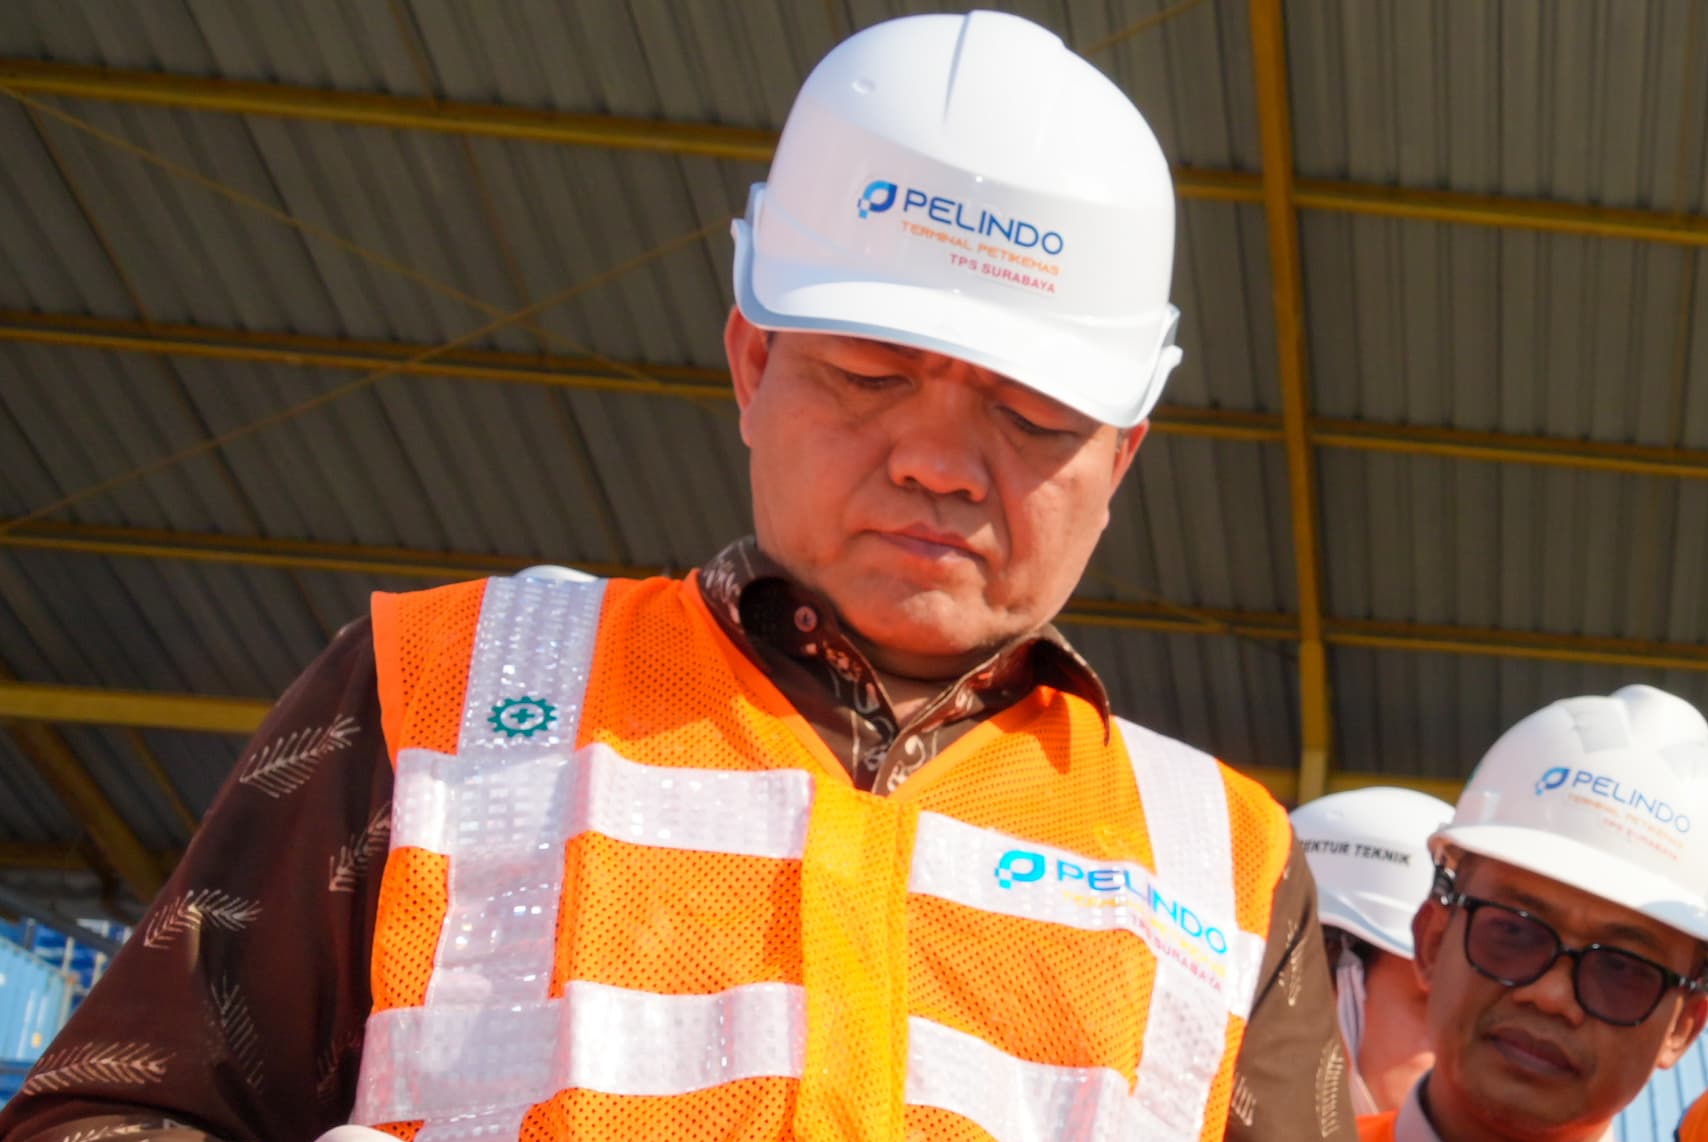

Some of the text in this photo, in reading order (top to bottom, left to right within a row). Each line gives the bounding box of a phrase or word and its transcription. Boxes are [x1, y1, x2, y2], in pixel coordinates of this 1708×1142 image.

[903, 188, 1064, 255] PELINDO
[950, 253, 1056, 294] TPS SURABAYA
[1571, 769, 1691, 833] PELINDO
[1299, 839, 1411, 867] EKTUR TEKNIK
[1056, 859, 1228, 955] PELINDO
